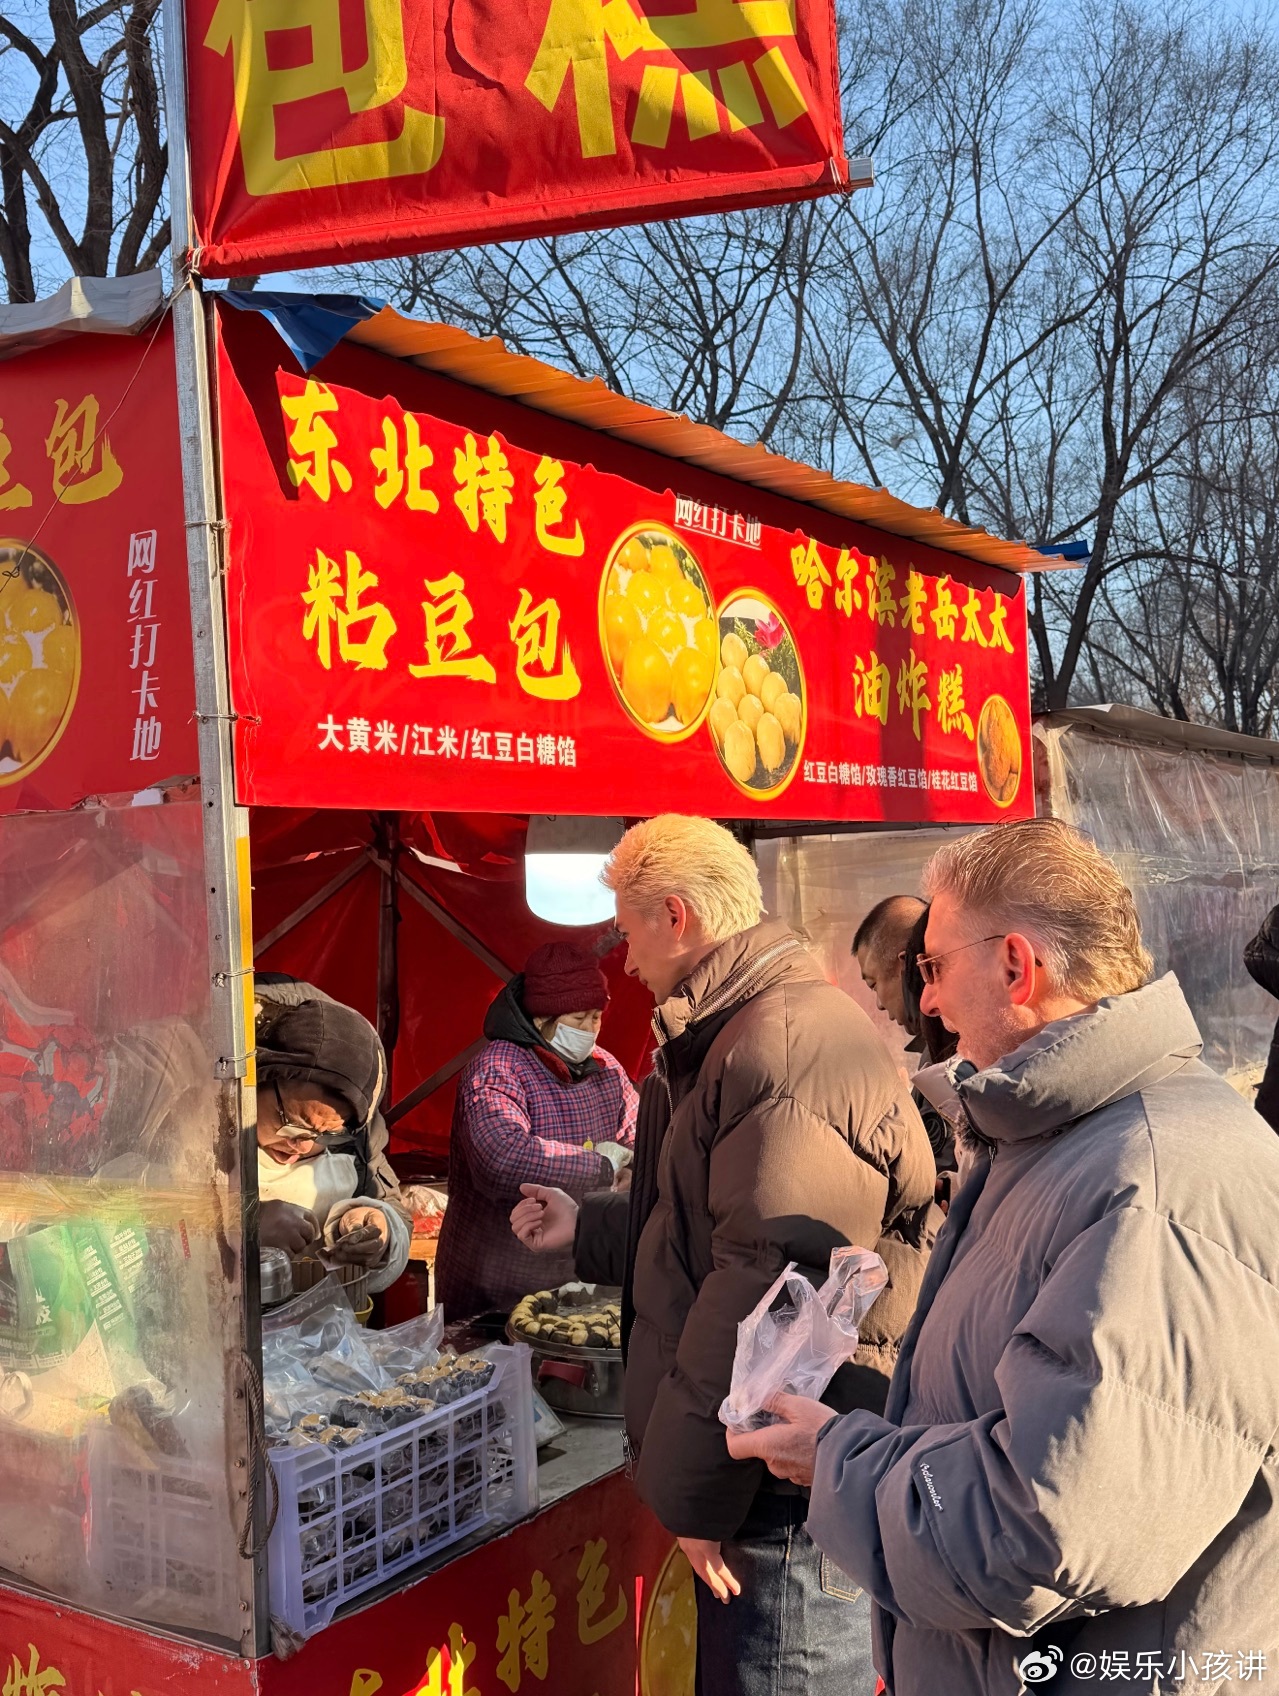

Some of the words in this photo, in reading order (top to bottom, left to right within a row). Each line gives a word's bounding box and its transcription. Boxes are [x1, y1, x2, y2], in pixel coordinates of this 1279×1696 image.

[0, 394, 124, 511] 包
[281, 375, 585, 557] 东北特色
[675, 493, 762, 546] 网红打卡地
[127, 529, 162, 762] 网红打卡地
[301, 548, 582, 701] 粘豆包
[790, 535, 1015, 655] 哈尔滨老岳太太
[317, 714, 577, 767] 大黄米/江米/红豆白糖馅
[853, 648, 975, 742] 油炸糕
